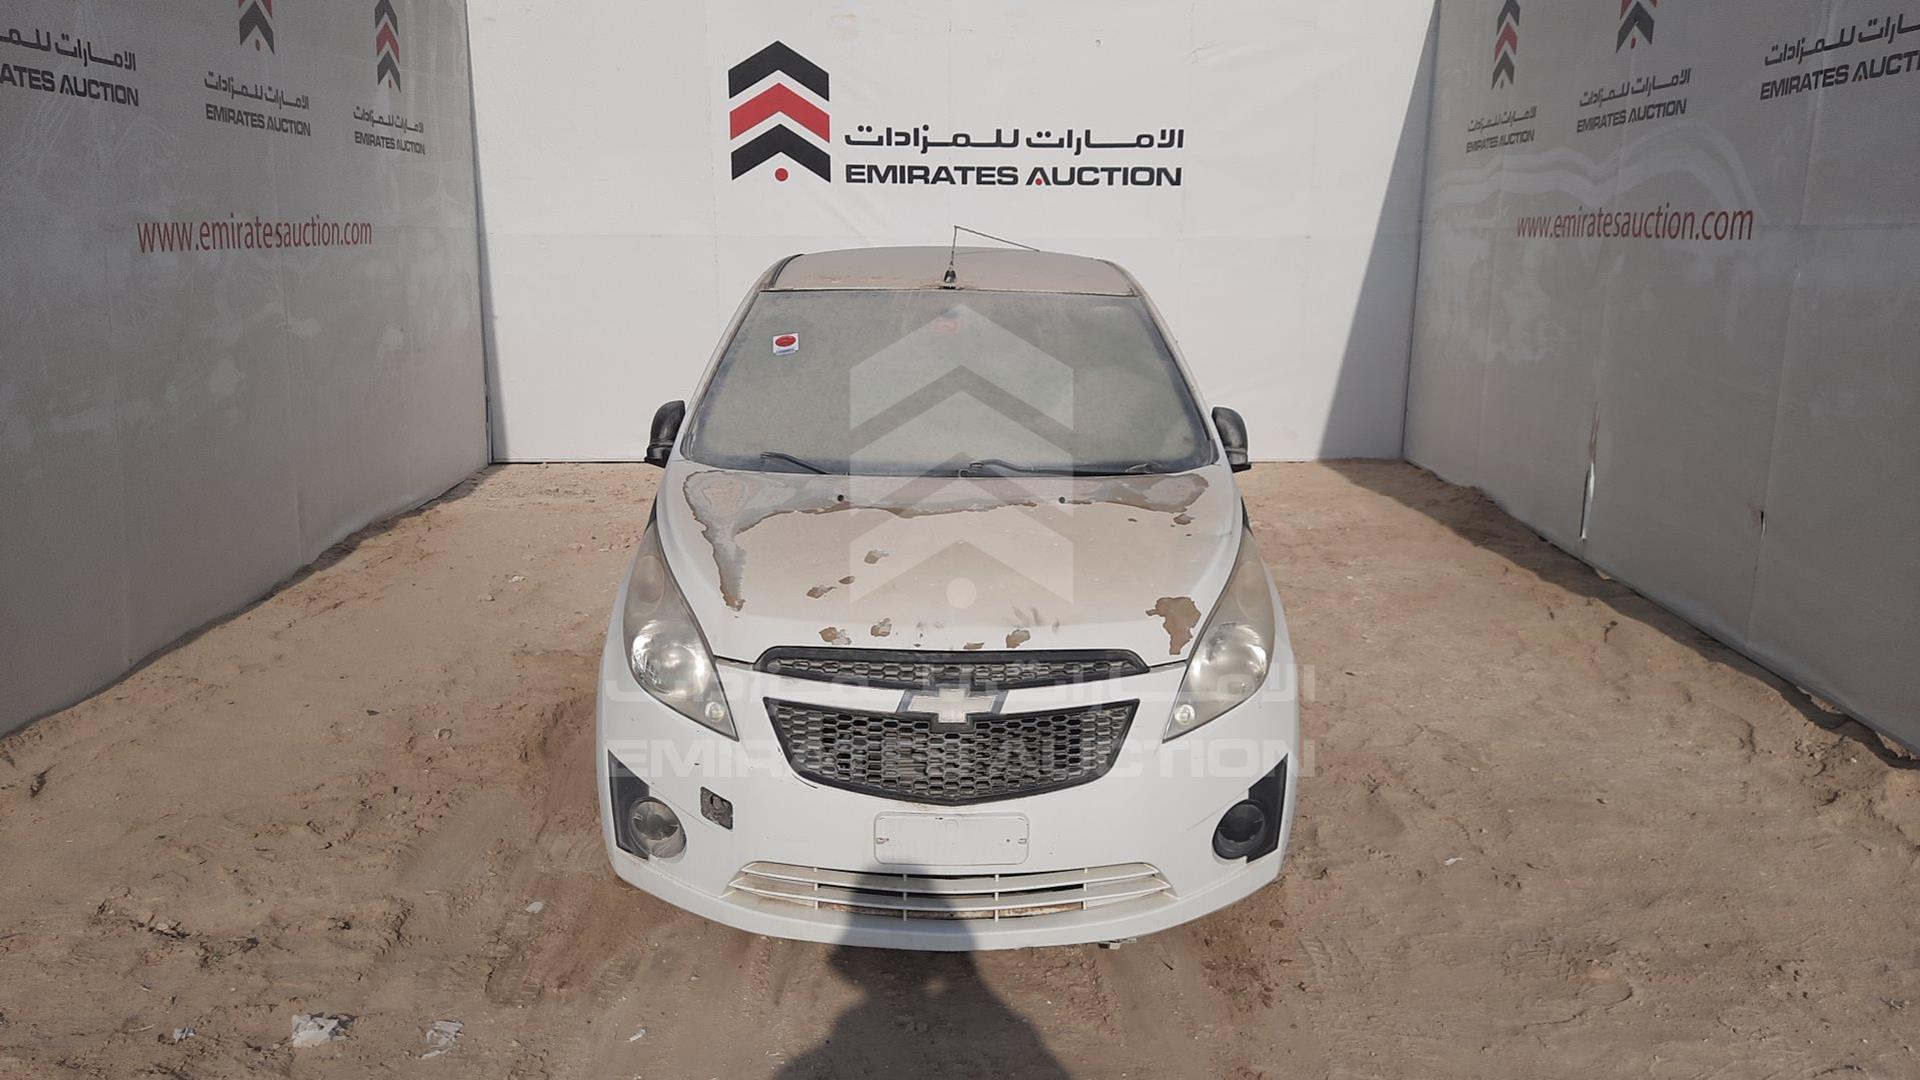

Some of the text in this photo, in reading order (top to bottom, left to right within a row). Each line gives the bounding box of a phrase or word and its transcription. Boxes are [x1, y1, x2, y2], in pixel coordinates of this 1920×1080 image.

[59, 74, 139, 107] AUCTION
[1760, 64, 1850, 100] EMIRATES
[205, 103, 311, 136] EMIRATES AUCTION
[1576, 98, 1687, 133] EMIRATES AUCTION
[354, 130, 426, 155] EMIRATES AUCTION
[845, 164, 1182, 187] EMIRATES AUCTION
[137, 212, 373, 253] www.emiratesauction.com
[1516, 203, 1754, 240] www.emiratesauction.com
